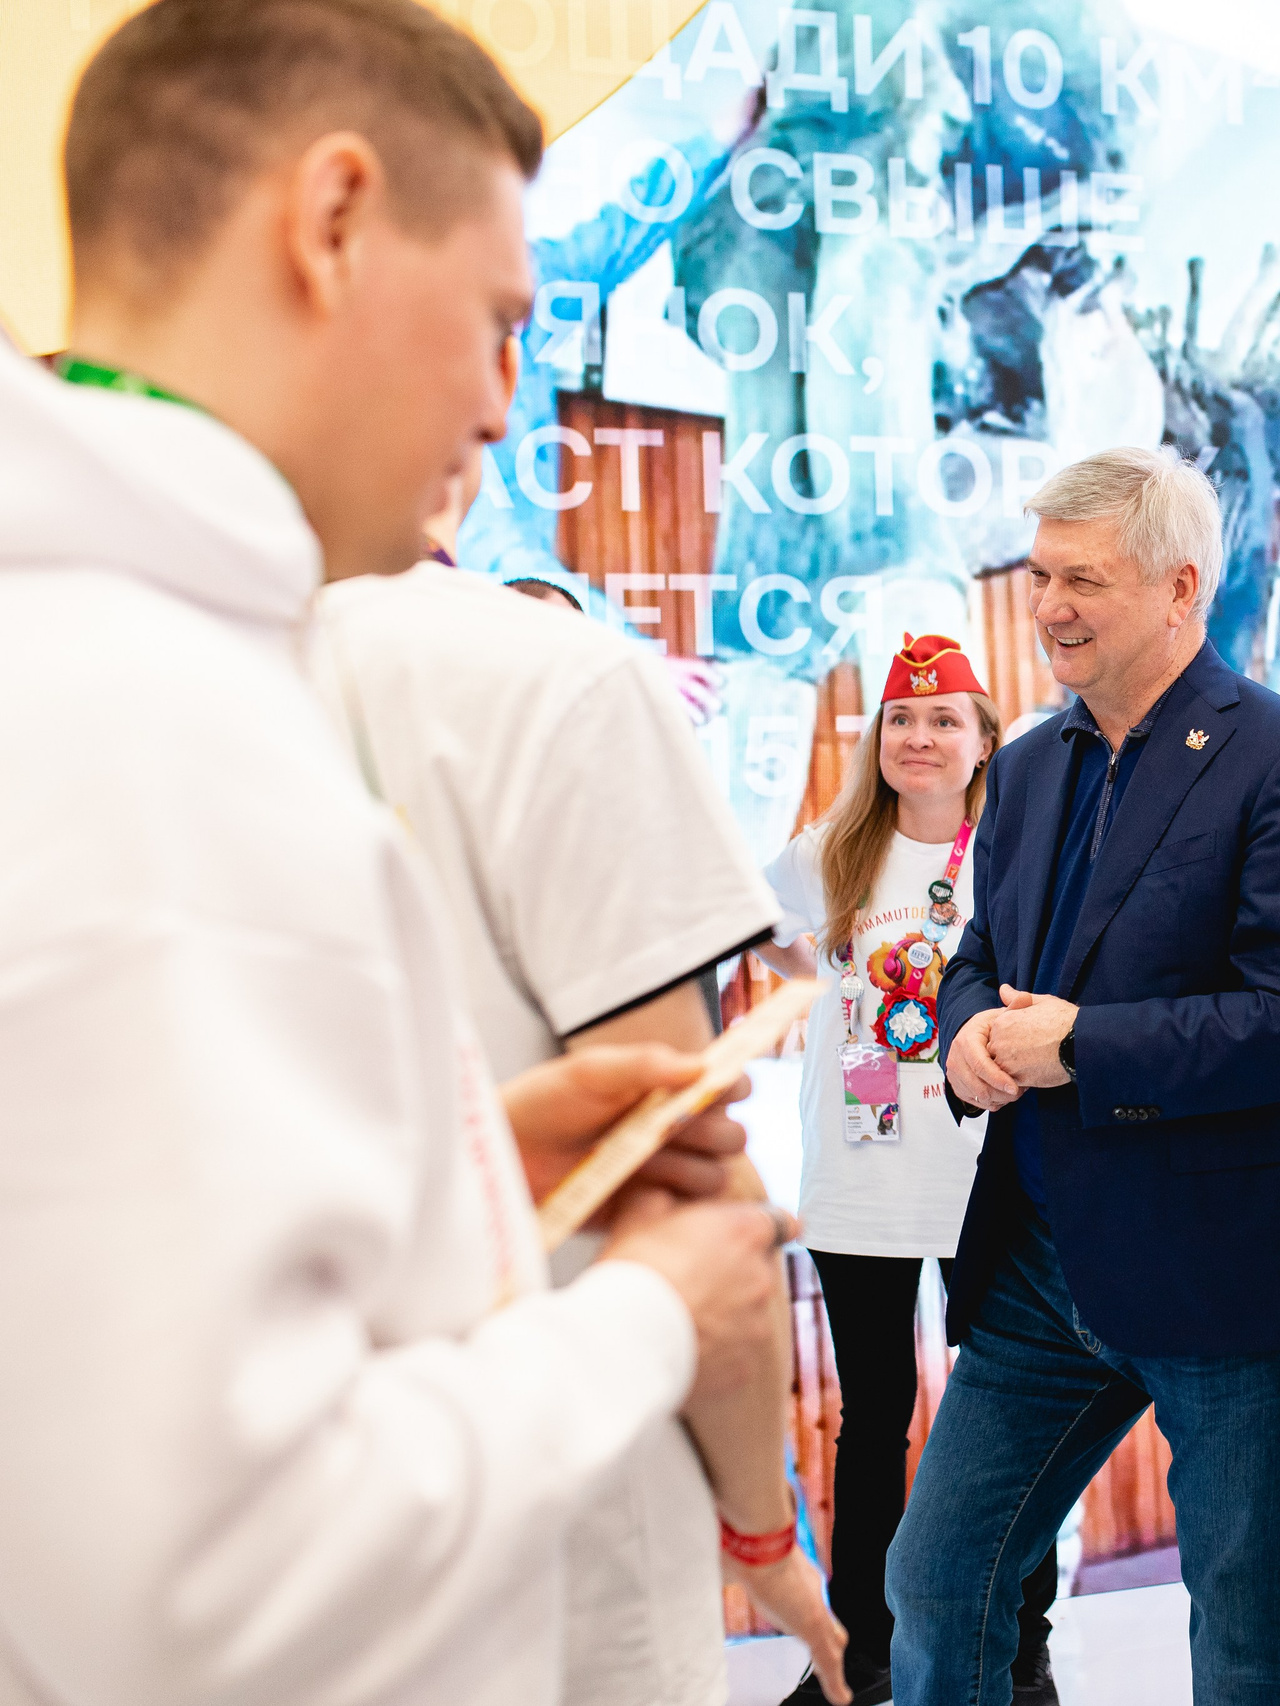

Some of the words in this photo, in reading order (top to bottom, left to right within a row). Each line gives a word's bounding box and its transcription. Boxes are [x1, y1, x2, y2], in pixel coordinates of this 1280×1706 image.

[471, 0, 924, 113] ОЩАДИ
[957, 25, 1065, 109] 10
[729, 147, 1145, 252] СВЫШЕ
[532, 280, 884, 395] ЯНОК,
[702, 431, 1064, 519] КОТОР
